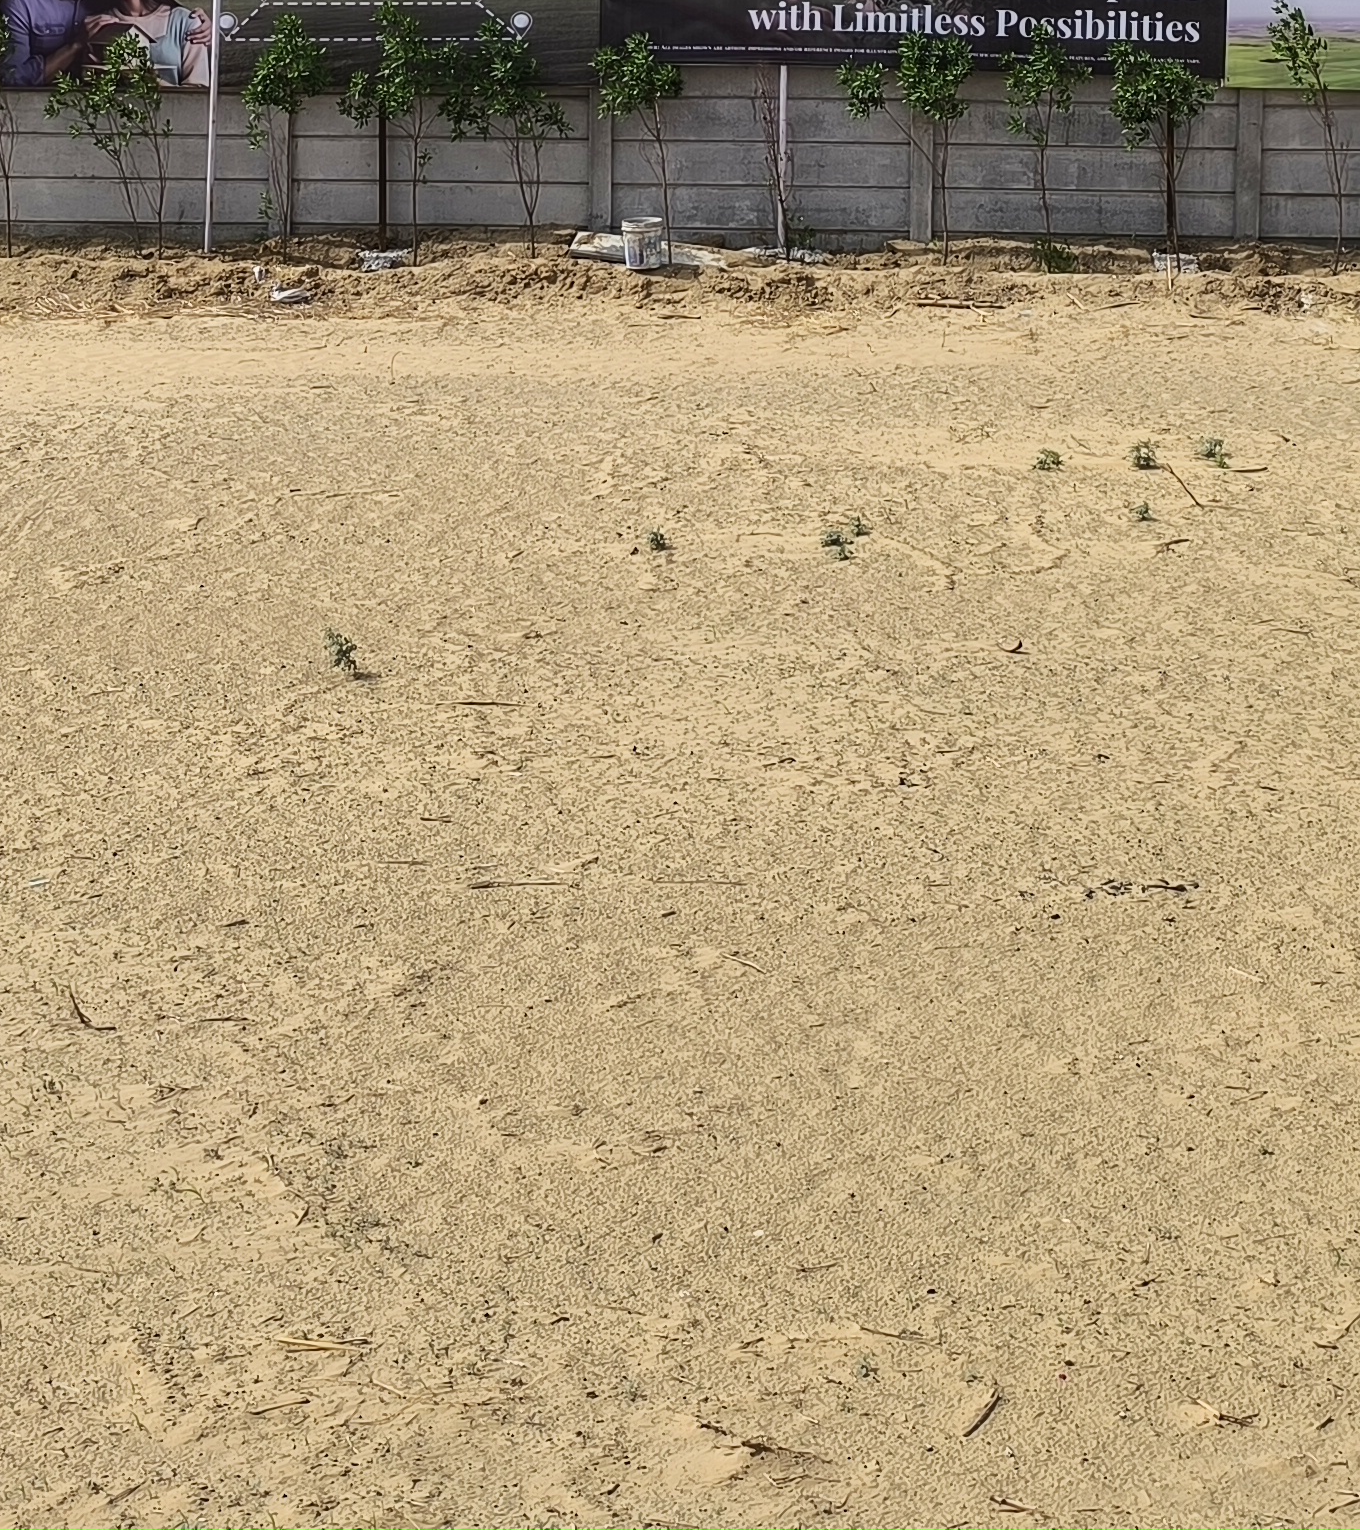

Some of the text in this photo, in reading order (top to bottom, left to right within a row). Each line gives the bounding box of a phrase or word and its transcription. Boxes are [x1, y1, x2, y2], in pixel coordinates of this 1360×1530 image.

[748, 0, 1201, 43] with Limitless Possibilities
